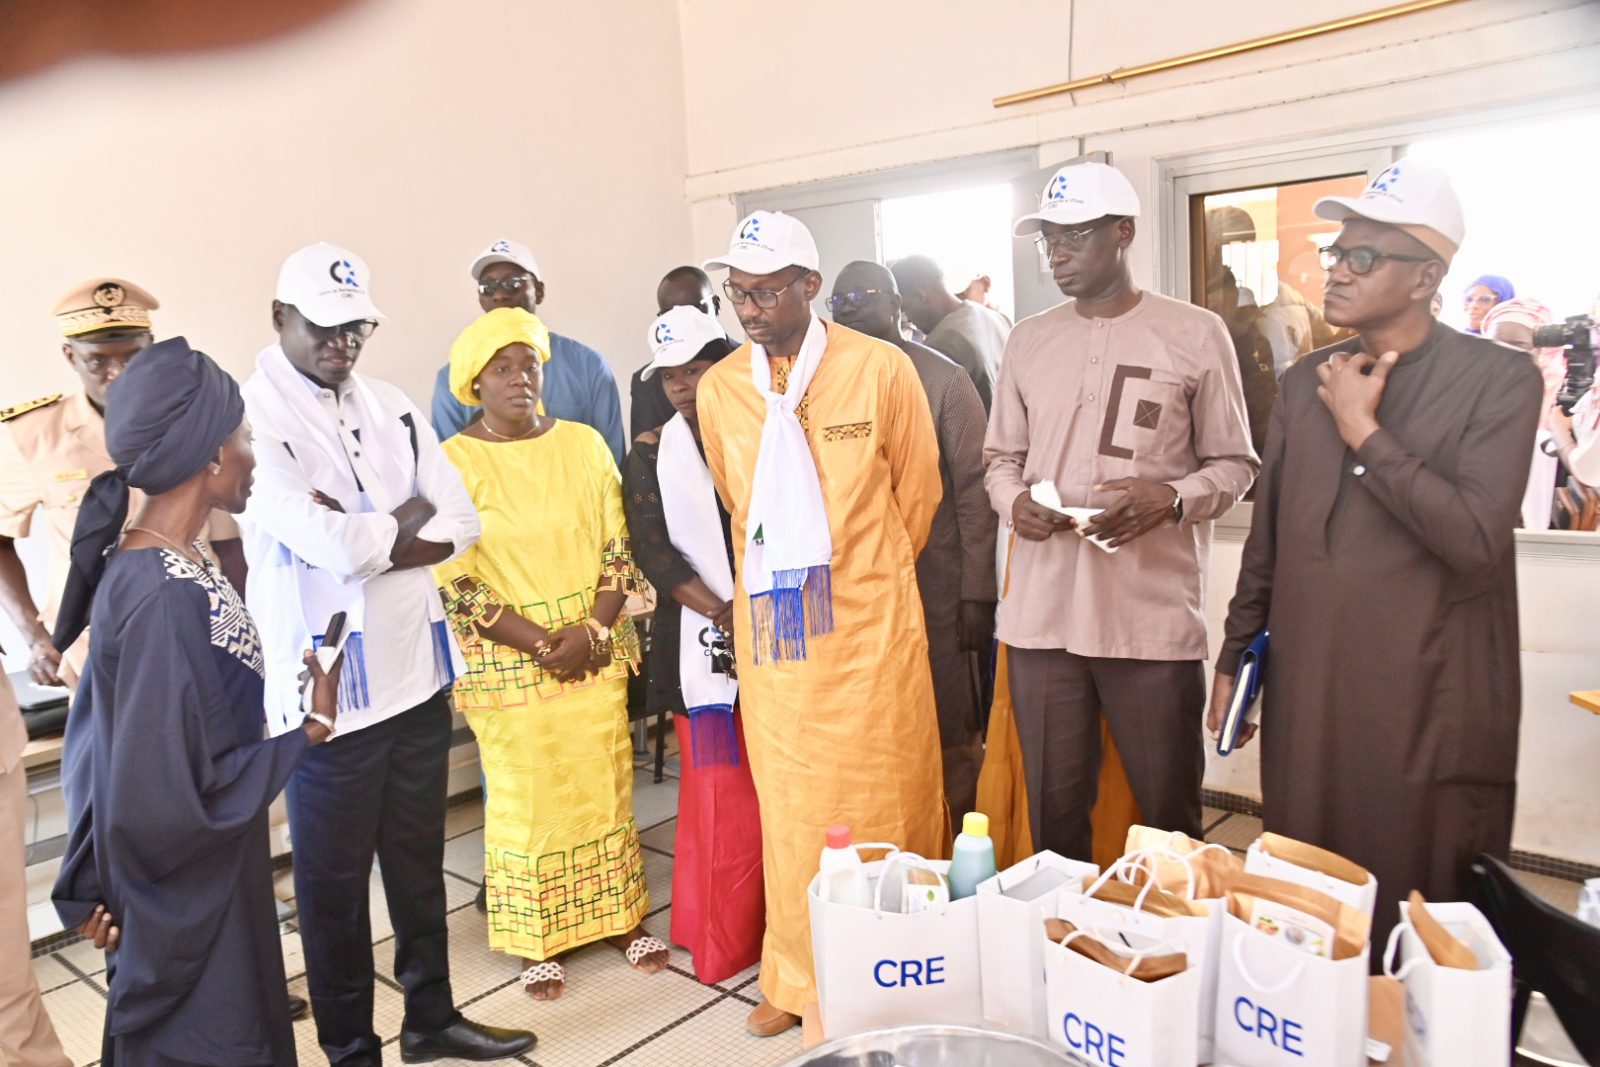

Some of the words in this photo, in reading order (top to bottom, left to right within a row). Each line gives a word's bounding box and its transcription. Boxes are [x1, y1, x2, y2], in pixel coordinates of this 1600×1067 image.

[874, 956, 945, 988] CRE
[1063, 1012, 1125, 1067] CRE
[1235, 996, 1304, 1056] CRE
